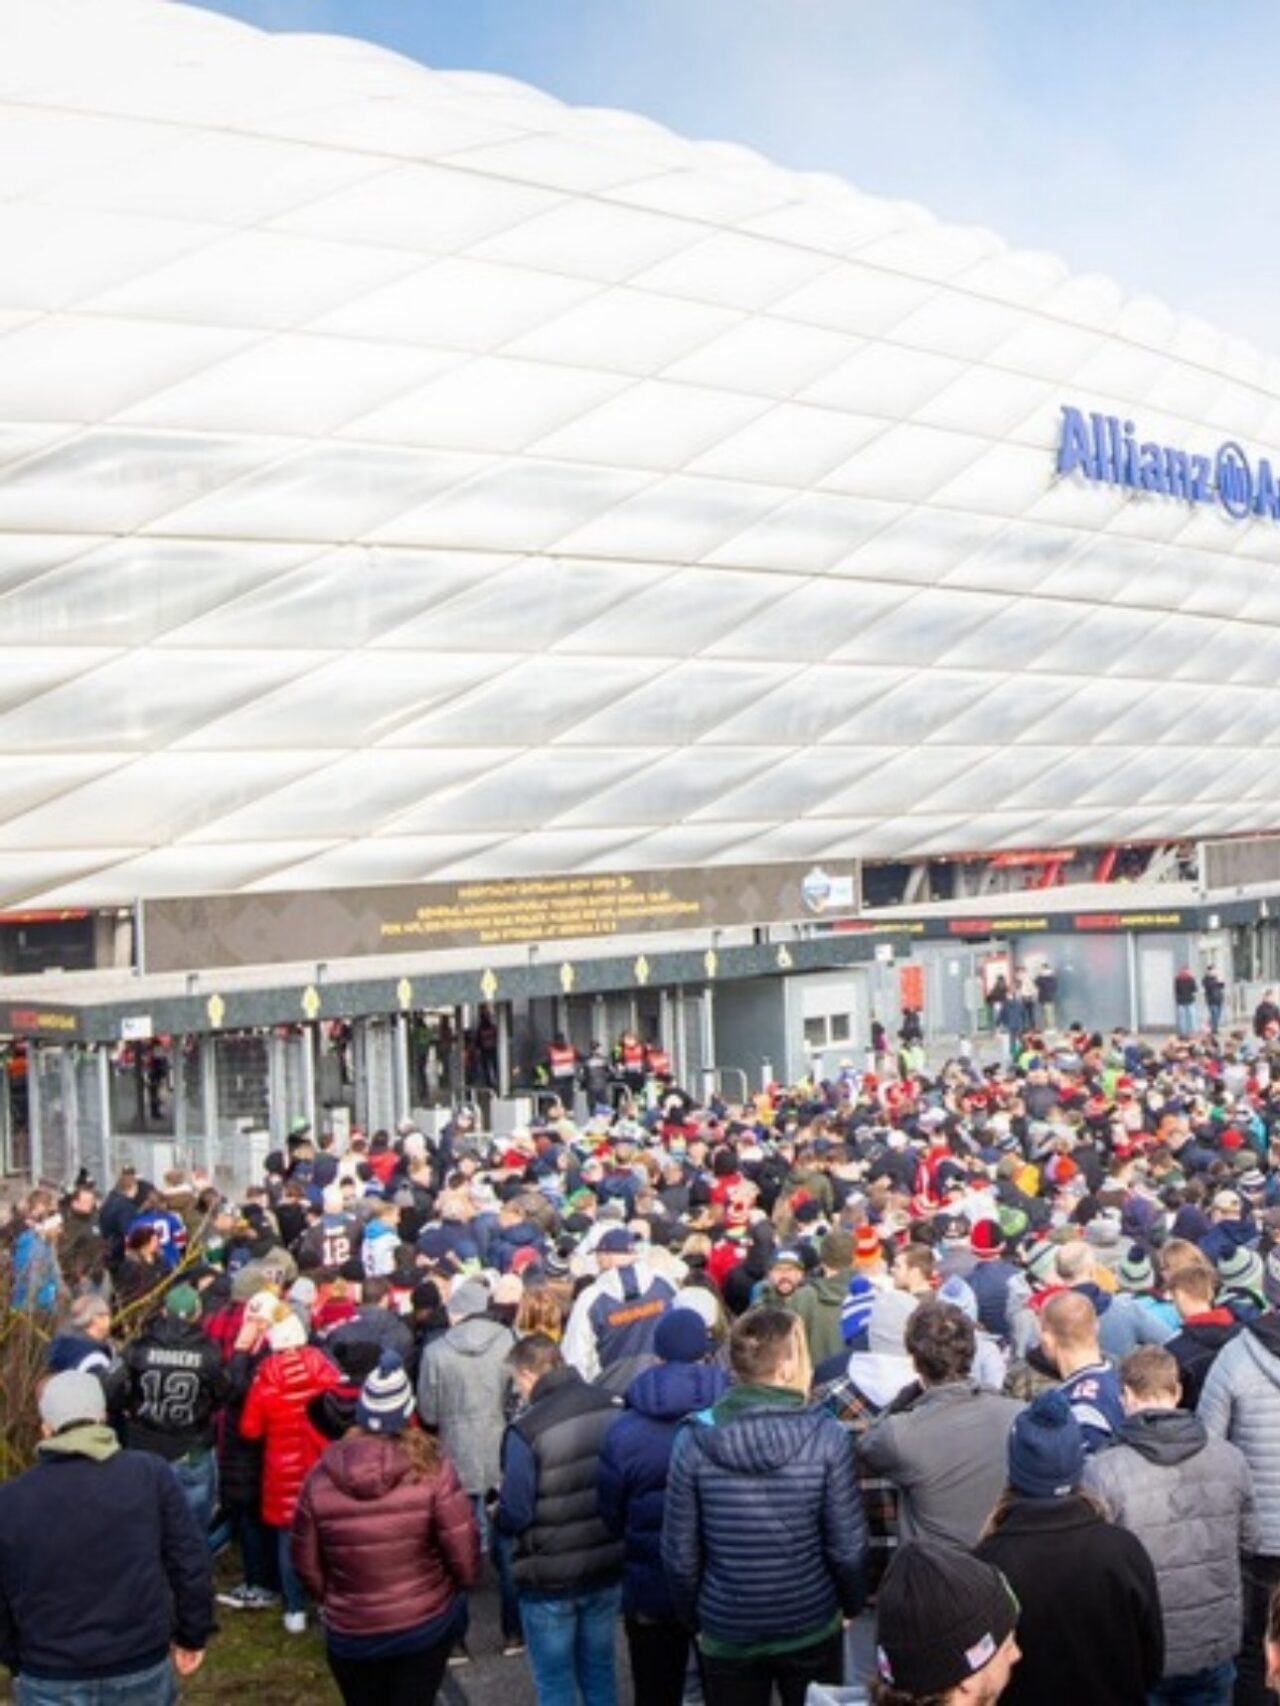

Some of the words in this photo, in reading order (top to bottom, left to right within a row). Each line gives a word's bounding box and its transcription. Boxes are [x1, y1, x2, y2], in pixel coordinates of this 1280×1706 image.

[1057, 405, 1215, 503] Allianz
[322, 1237, 351, 1266] 12
[138, 1369, 200, 1424] 12
